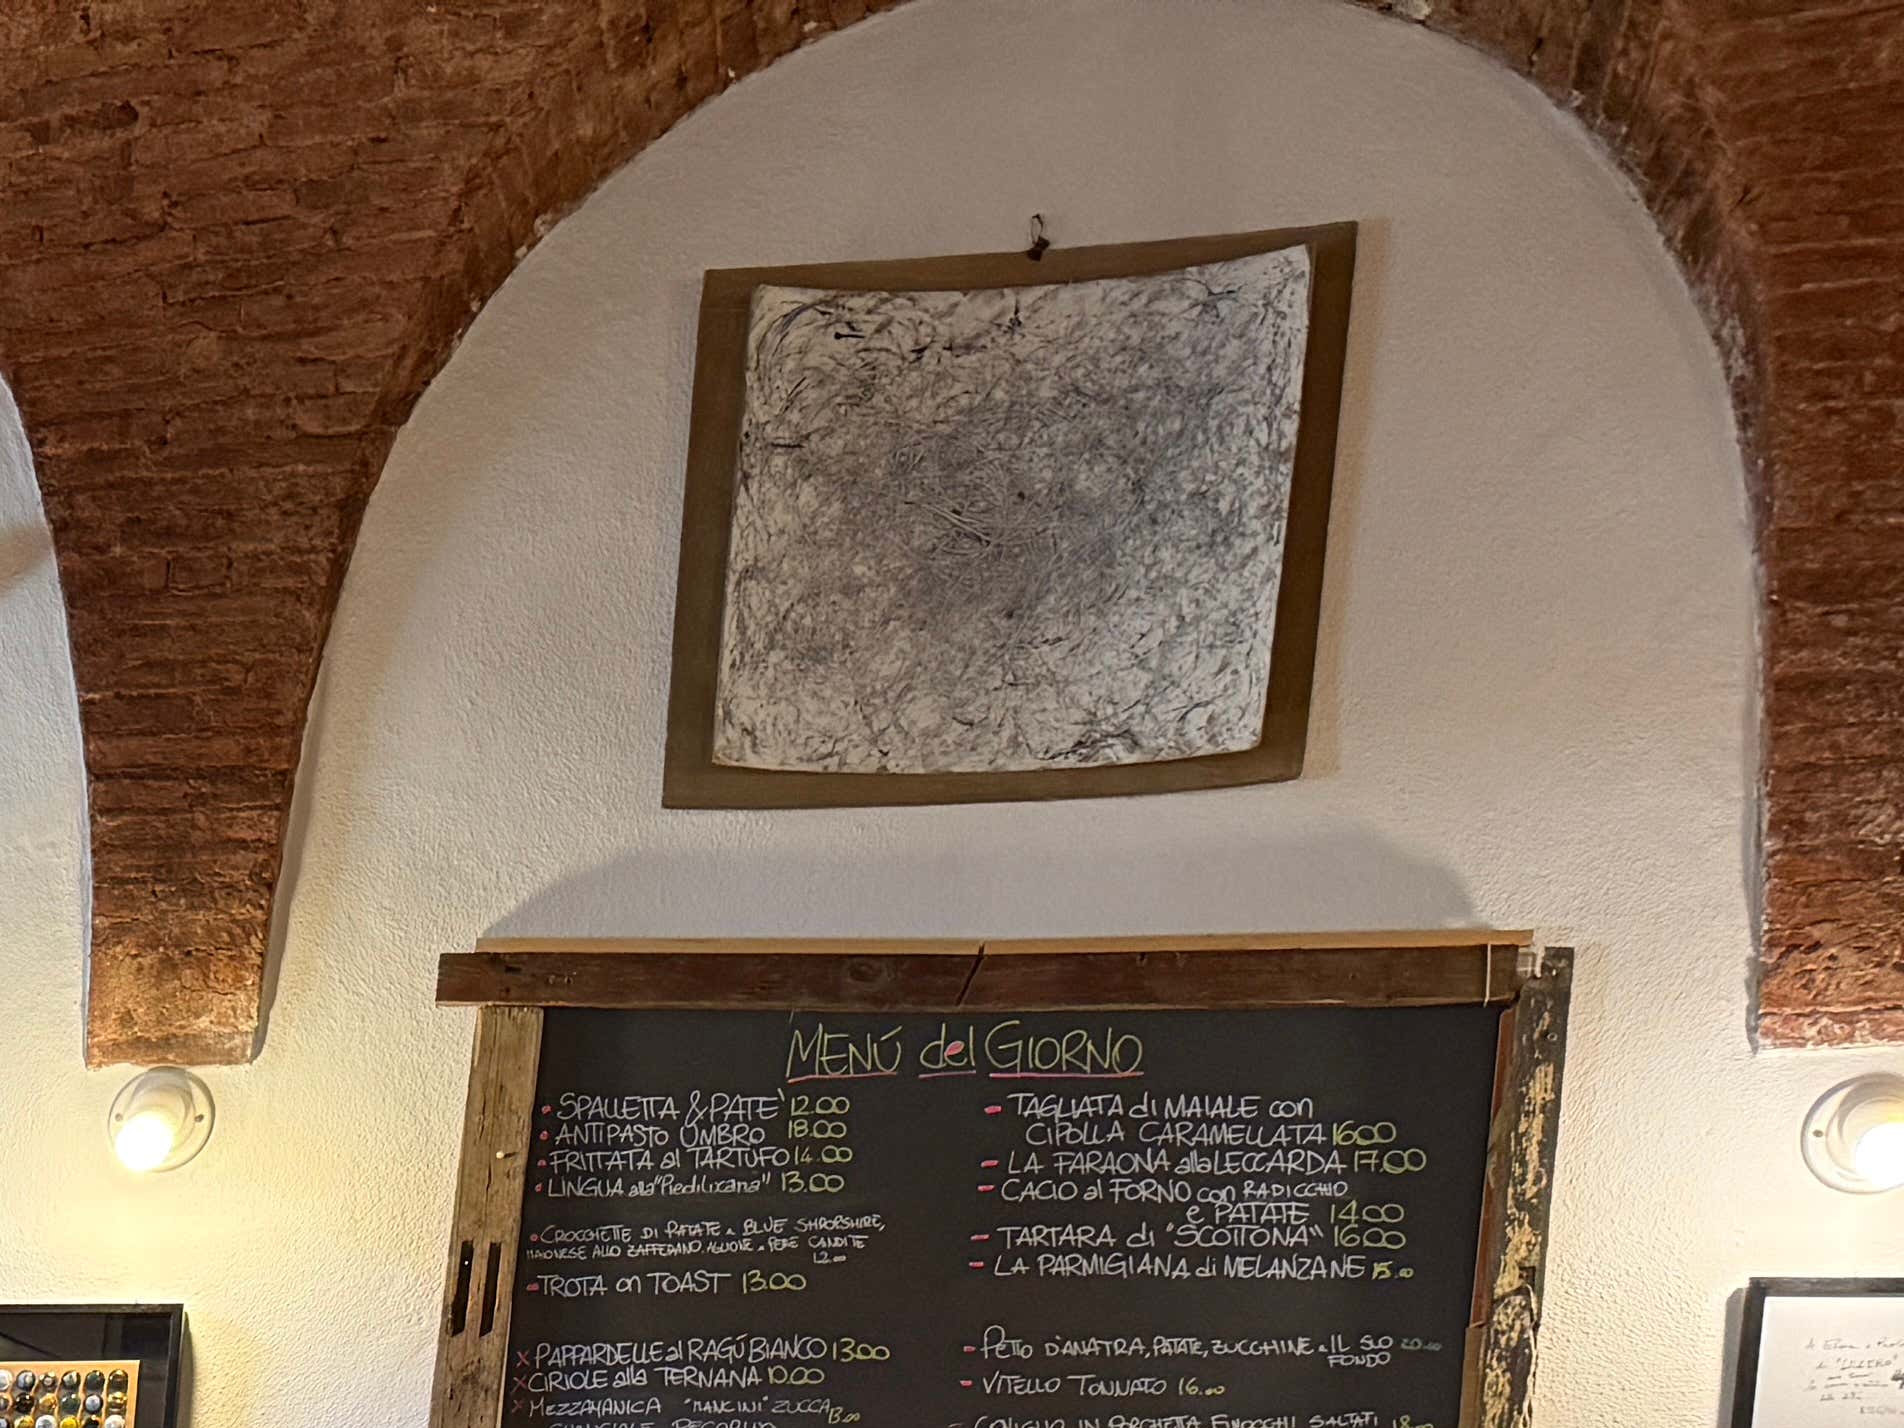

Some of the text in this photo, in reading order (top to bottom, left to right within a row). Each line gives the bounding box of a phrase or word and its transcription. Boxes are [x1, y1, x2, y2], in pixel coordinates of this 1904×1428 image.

[919, 1023, 975, 1069] del
[985, 1020, 1144, 1075] GIORNO
[557, 1091, 850, 1121] SPALLETTA 12.00
[1007, 1091, 1313, 1120] TAGLIATA di MAIALE con
[554, 1120, 847, 1147] ANTIPASTO UMBRO 18.00
[1025, 1121, 1327, 1147] CIPOLLA CARAMELLATA
[549, 1146, 790, 1174] FRITTATA al TARTUFO
[1008, 1149, 1347, 1175] LA FARAONA LECCARDA
[548, 1171, 844, 1198] LINGUA 13.00
[1001, 1178, 1236, 1203] CACIO al FORNO con
[1185, 1202, 1310, 1224] e PATATE
[541, 1217, 787, 1244] CROCCHETTE BLUE
[996, 1222, 1155, 1249] TARTARA di
[994, 1254, 1366, 1280] LA PARMIGIANA di MELANZANE
[537, 1269, 807, 1298] TROTA TOAST 13.00
[535, 1334, 827, 1367] PAPPARDELLE BIANCO
[1212, 1336, 1314, 1356] ZUCCHINE
[1327, 1352, 1391, 1369] FONDO
[528, 1365, 763, 1393] CIRIOLE alla TERNANA
[982, 1370, 1225, 1396] VITELLO TONNATO 16.00
[771, 1399, 830, 1415] ZUCCA
[1308, 1411, 1379, 1428] SALTATI
